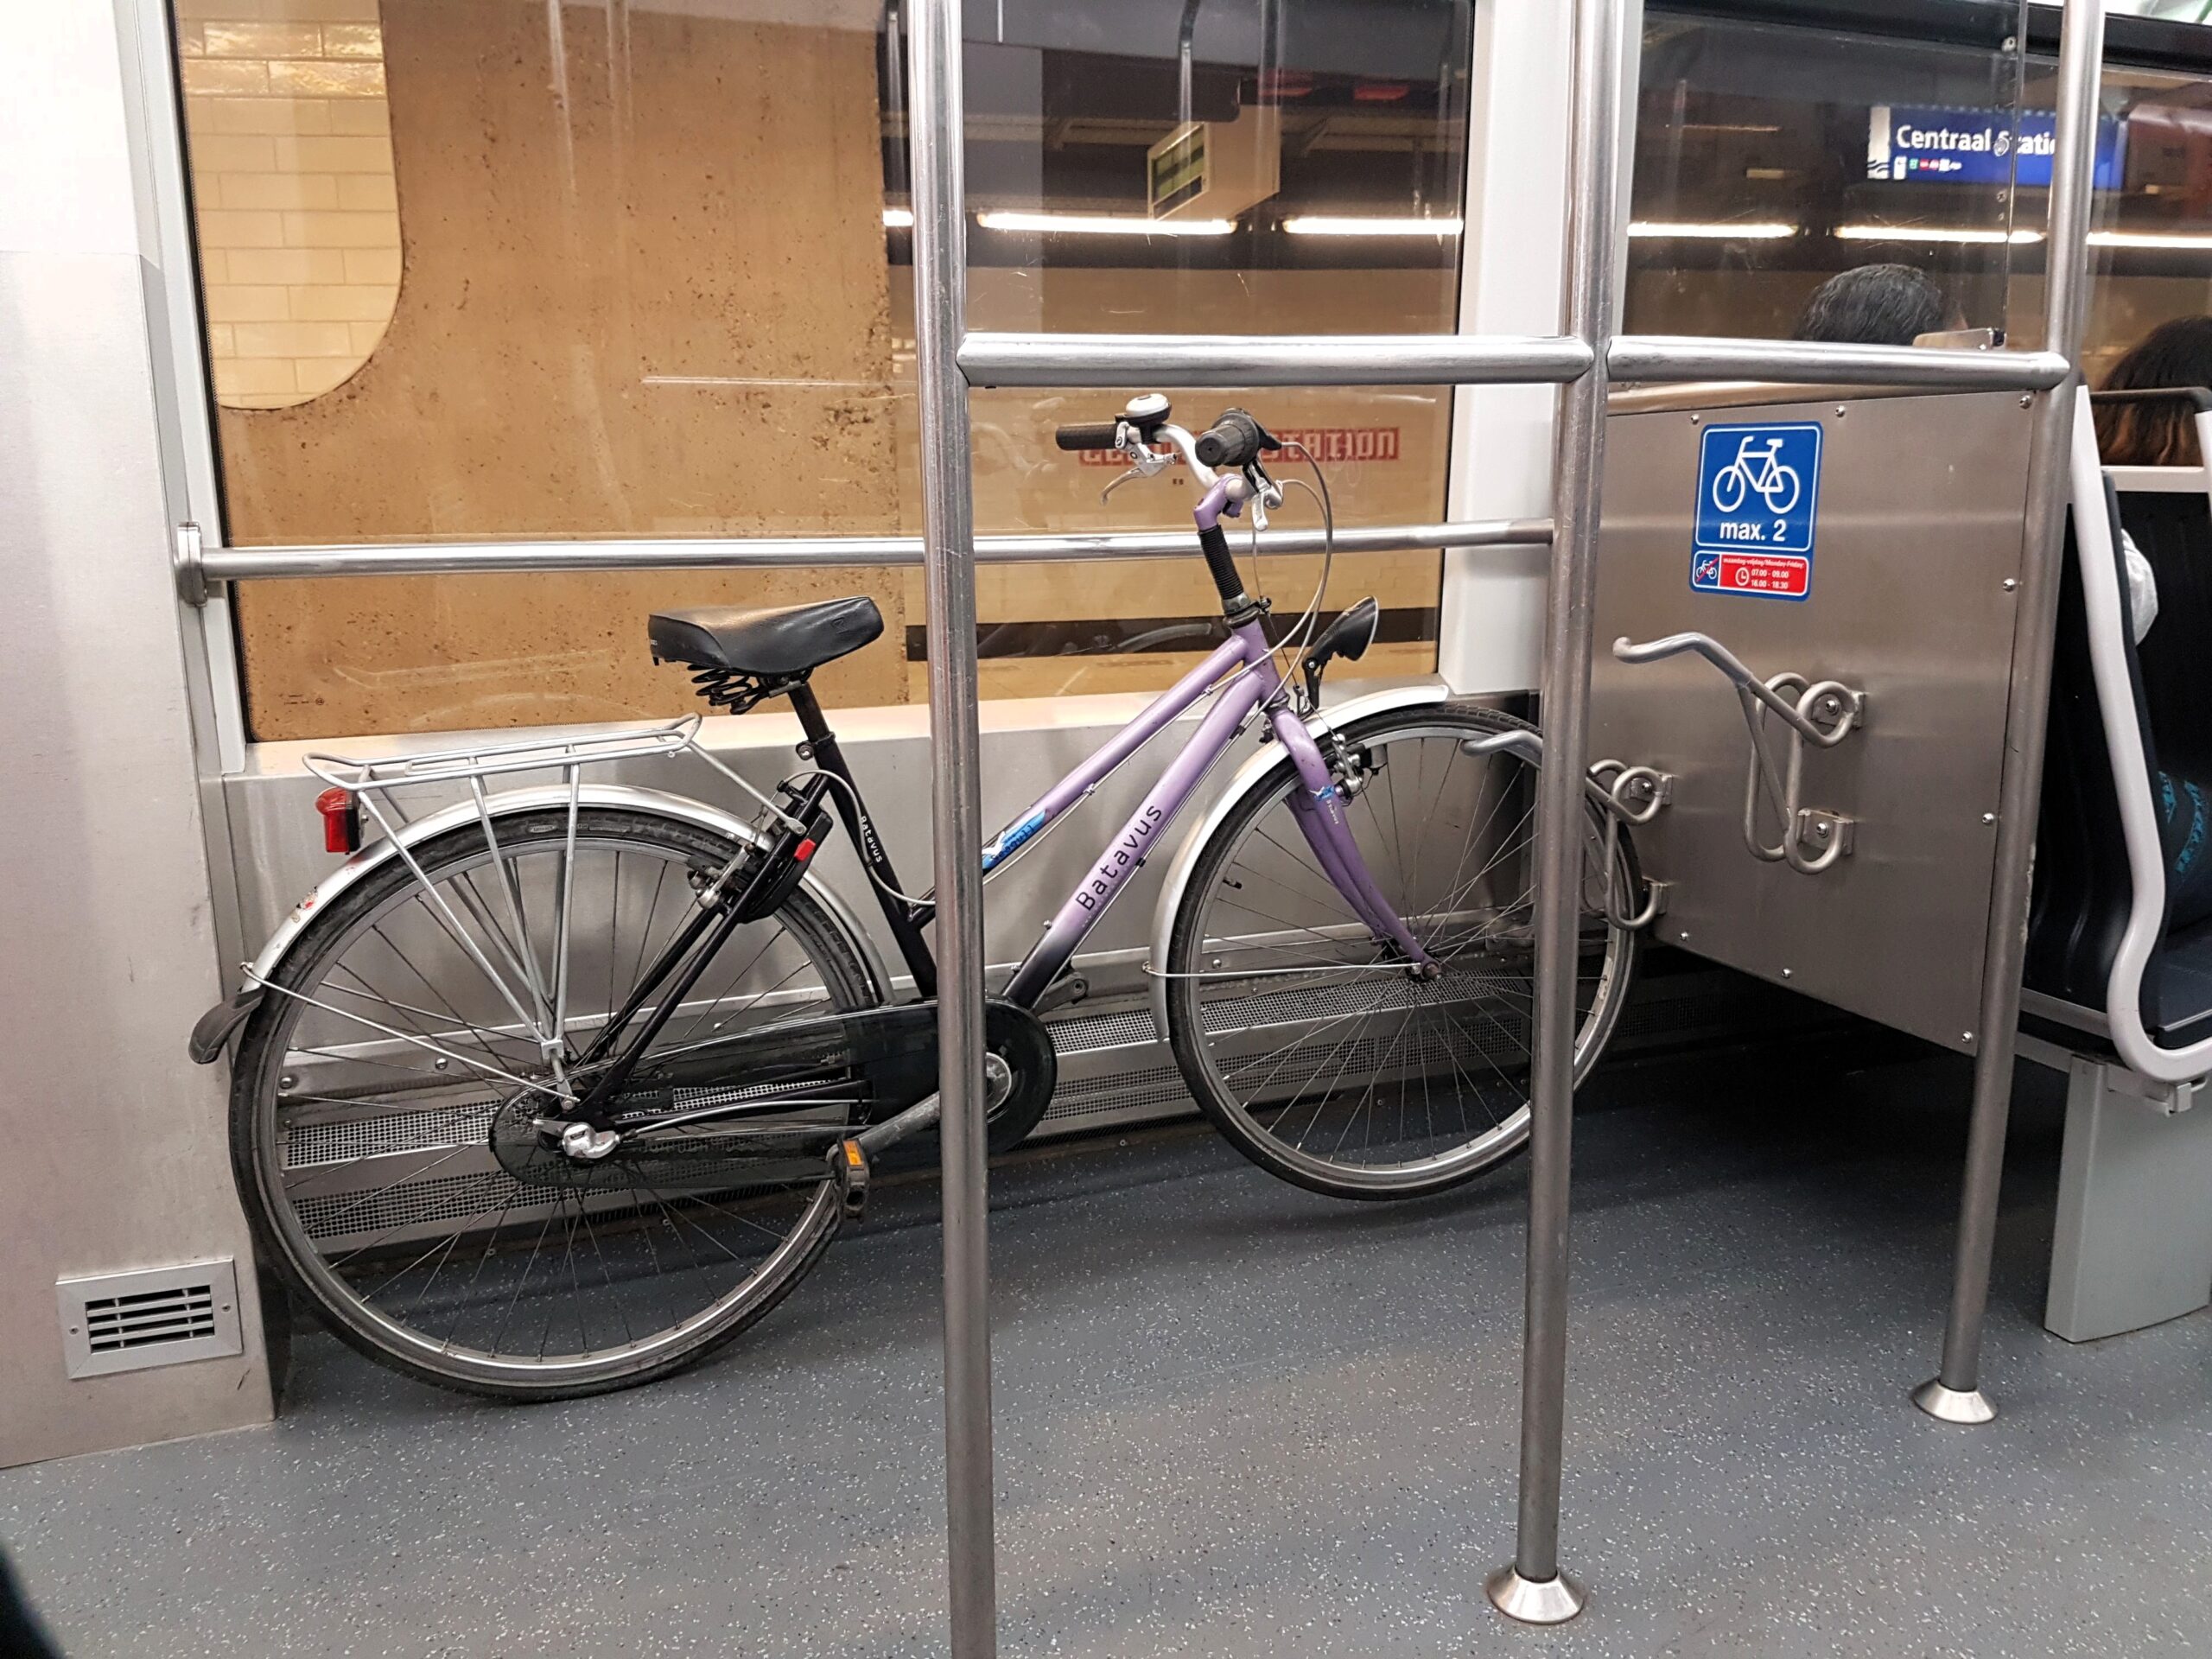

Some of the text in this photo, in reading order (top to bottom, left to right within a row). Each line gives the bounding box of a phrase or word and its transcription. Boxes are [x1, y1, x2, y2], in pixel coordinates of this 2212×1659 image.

[1896, 124, 1993, 152] Centraal
[1719, 519, 1787, 542] max. 2
[1751, 569, 1768, 577] 07.00
[861, 816, 883, 862] Batavus
[1075, 805, 1162, 911] Batavus
